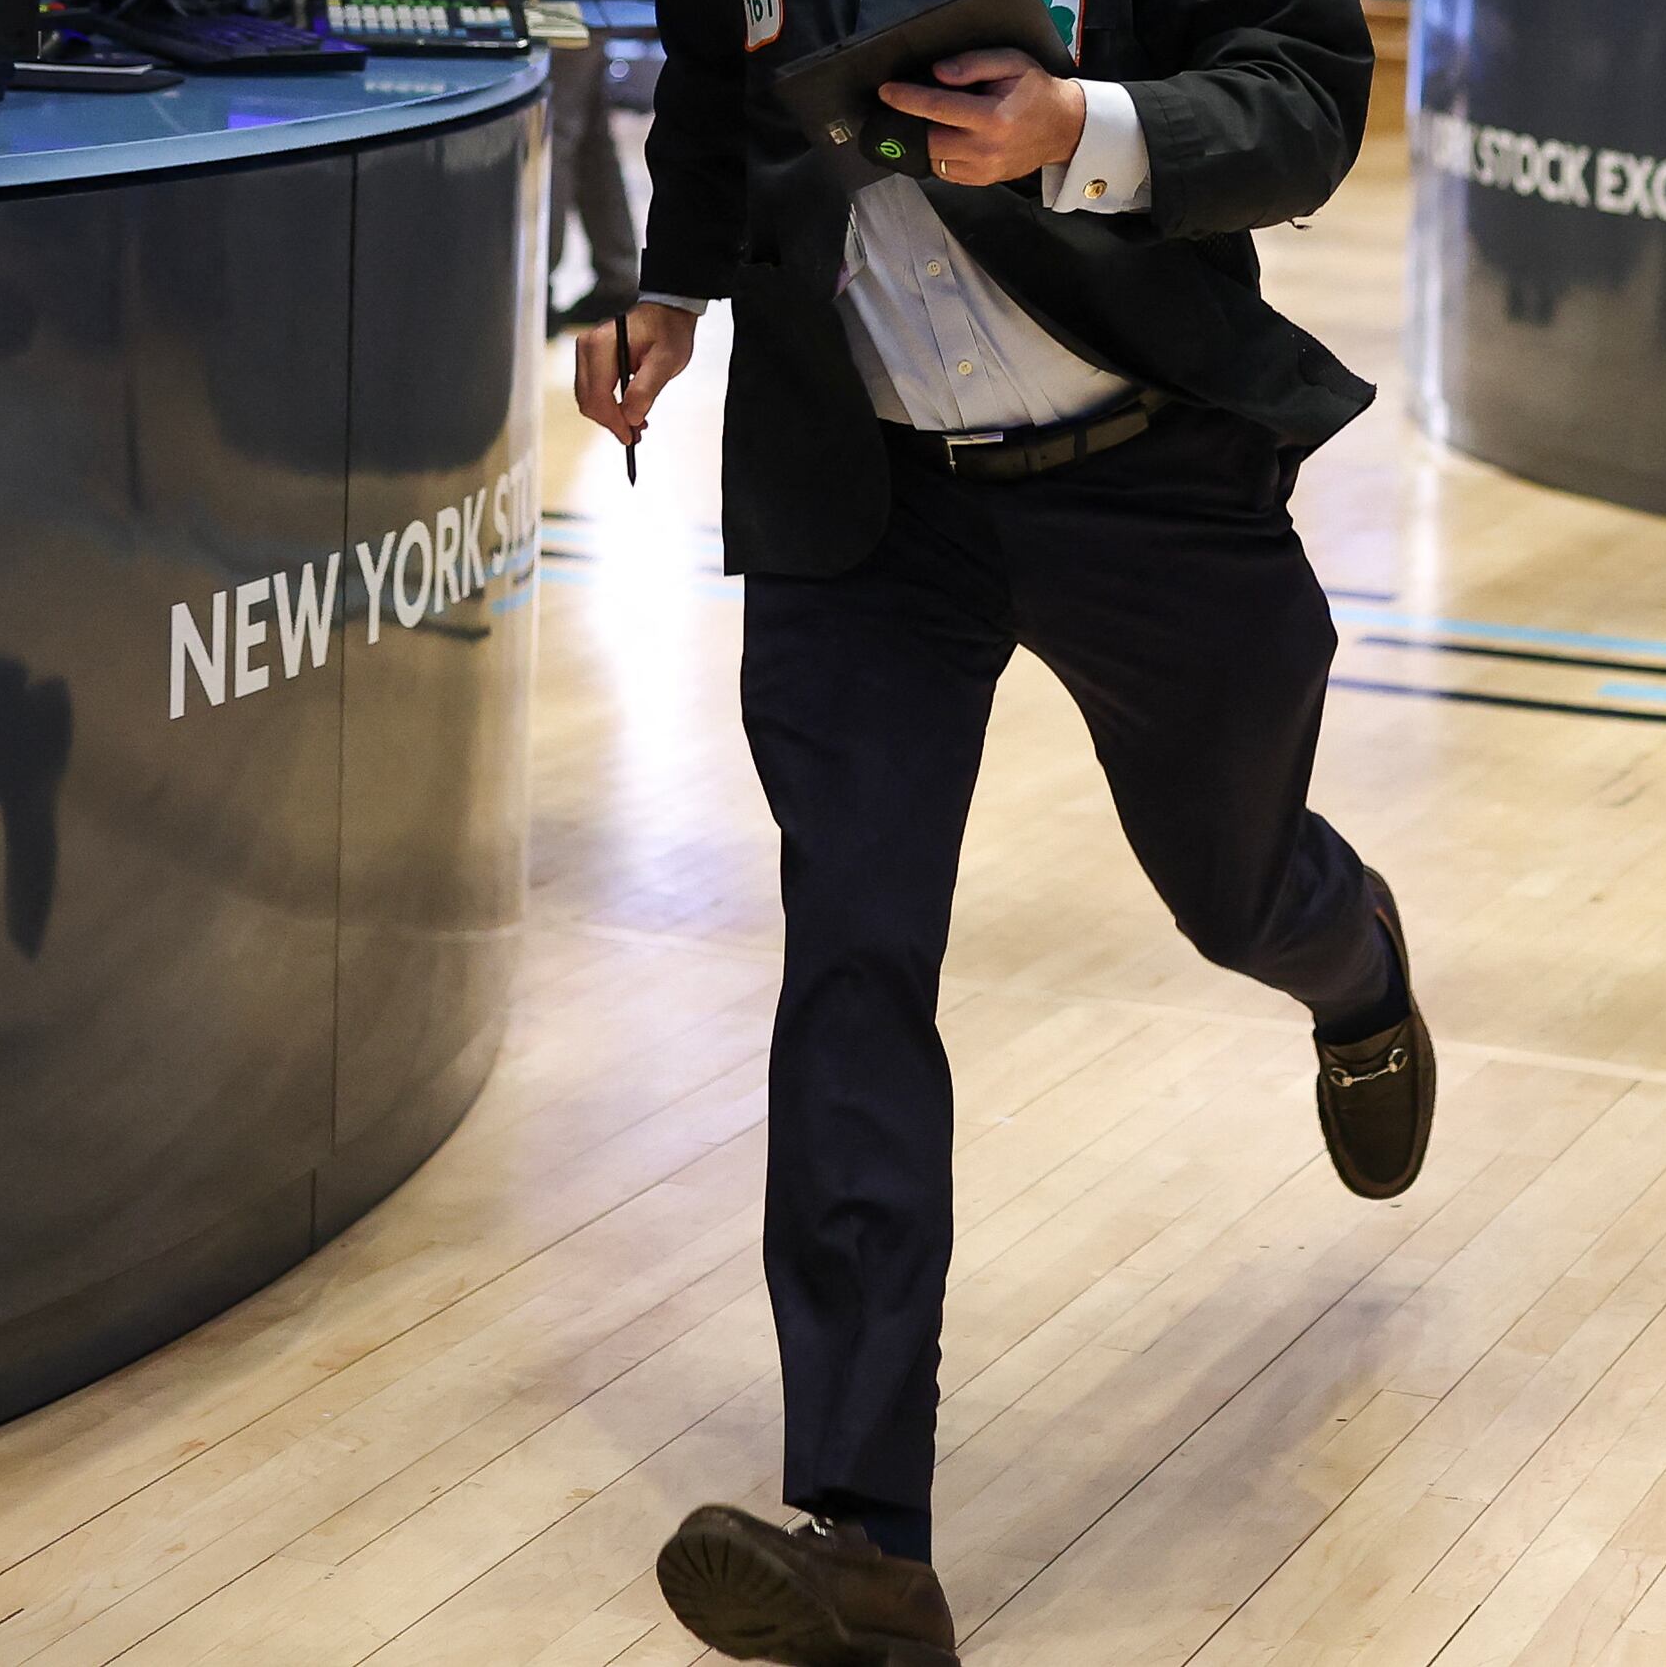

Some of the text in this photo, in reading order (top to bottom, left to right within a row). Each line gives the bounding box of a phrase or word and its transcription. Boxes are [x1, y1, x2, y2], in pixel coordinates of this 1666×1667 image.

[1474, 125, 1591, 207] STOCK
[170, 551, 340, 720] NEW
[355, 487, 485, 645] YORK
